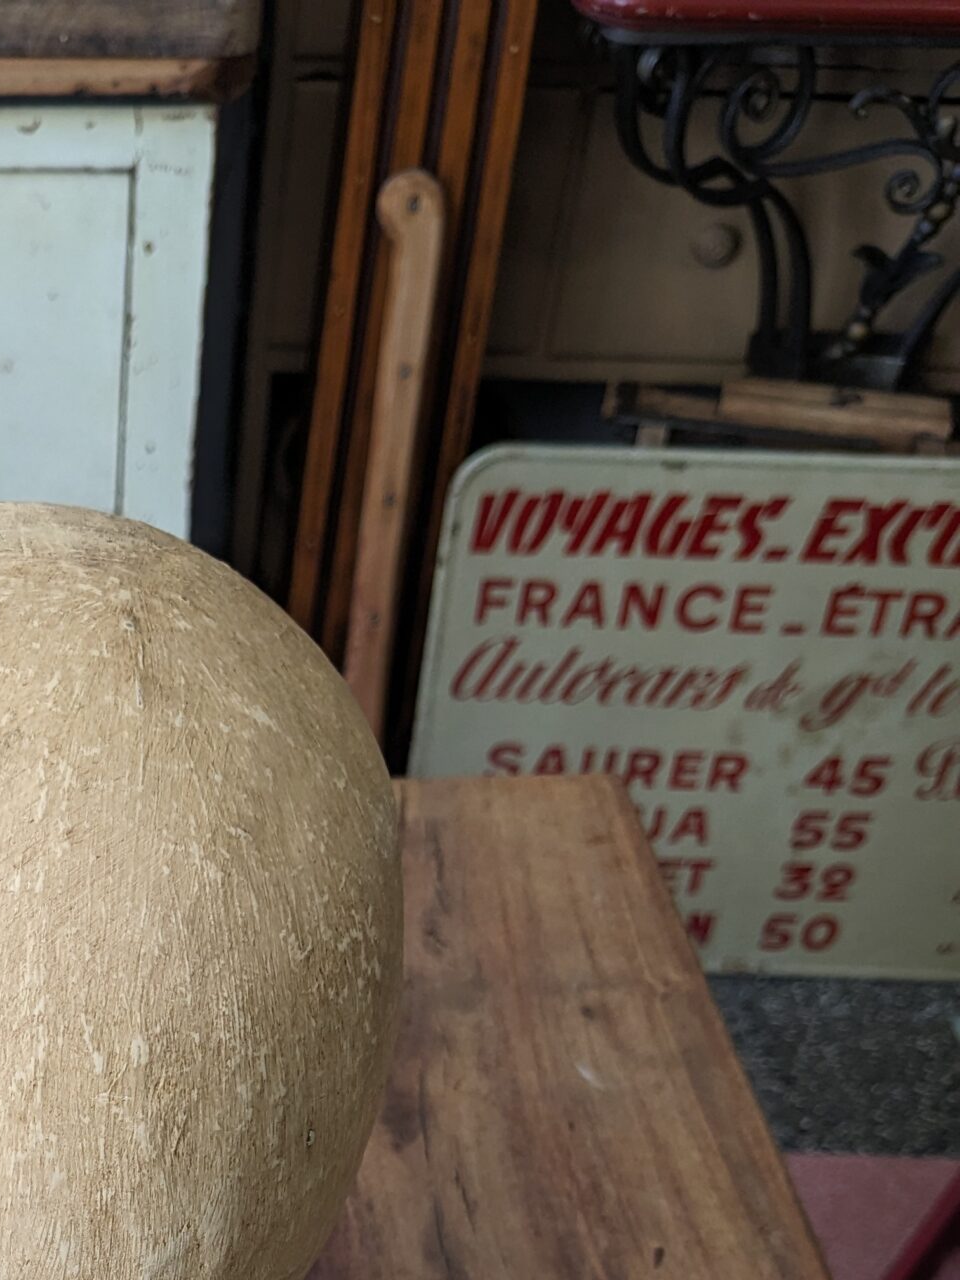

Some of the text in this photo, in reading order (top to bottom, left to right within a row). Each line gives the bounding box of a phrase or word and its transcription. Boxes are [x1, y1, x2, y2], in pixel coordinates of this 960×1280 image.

[468, 487, 792, 561] VOYAGES
[474, 576, 776, 634] FRANCE
[485, 740, 751, 792] SAURER
[802, 751, 893, 798] 45
[790, 808, 872, 852] 55
[773, 860, 856, 903] 32
[758, 912, 841, 952] 50
